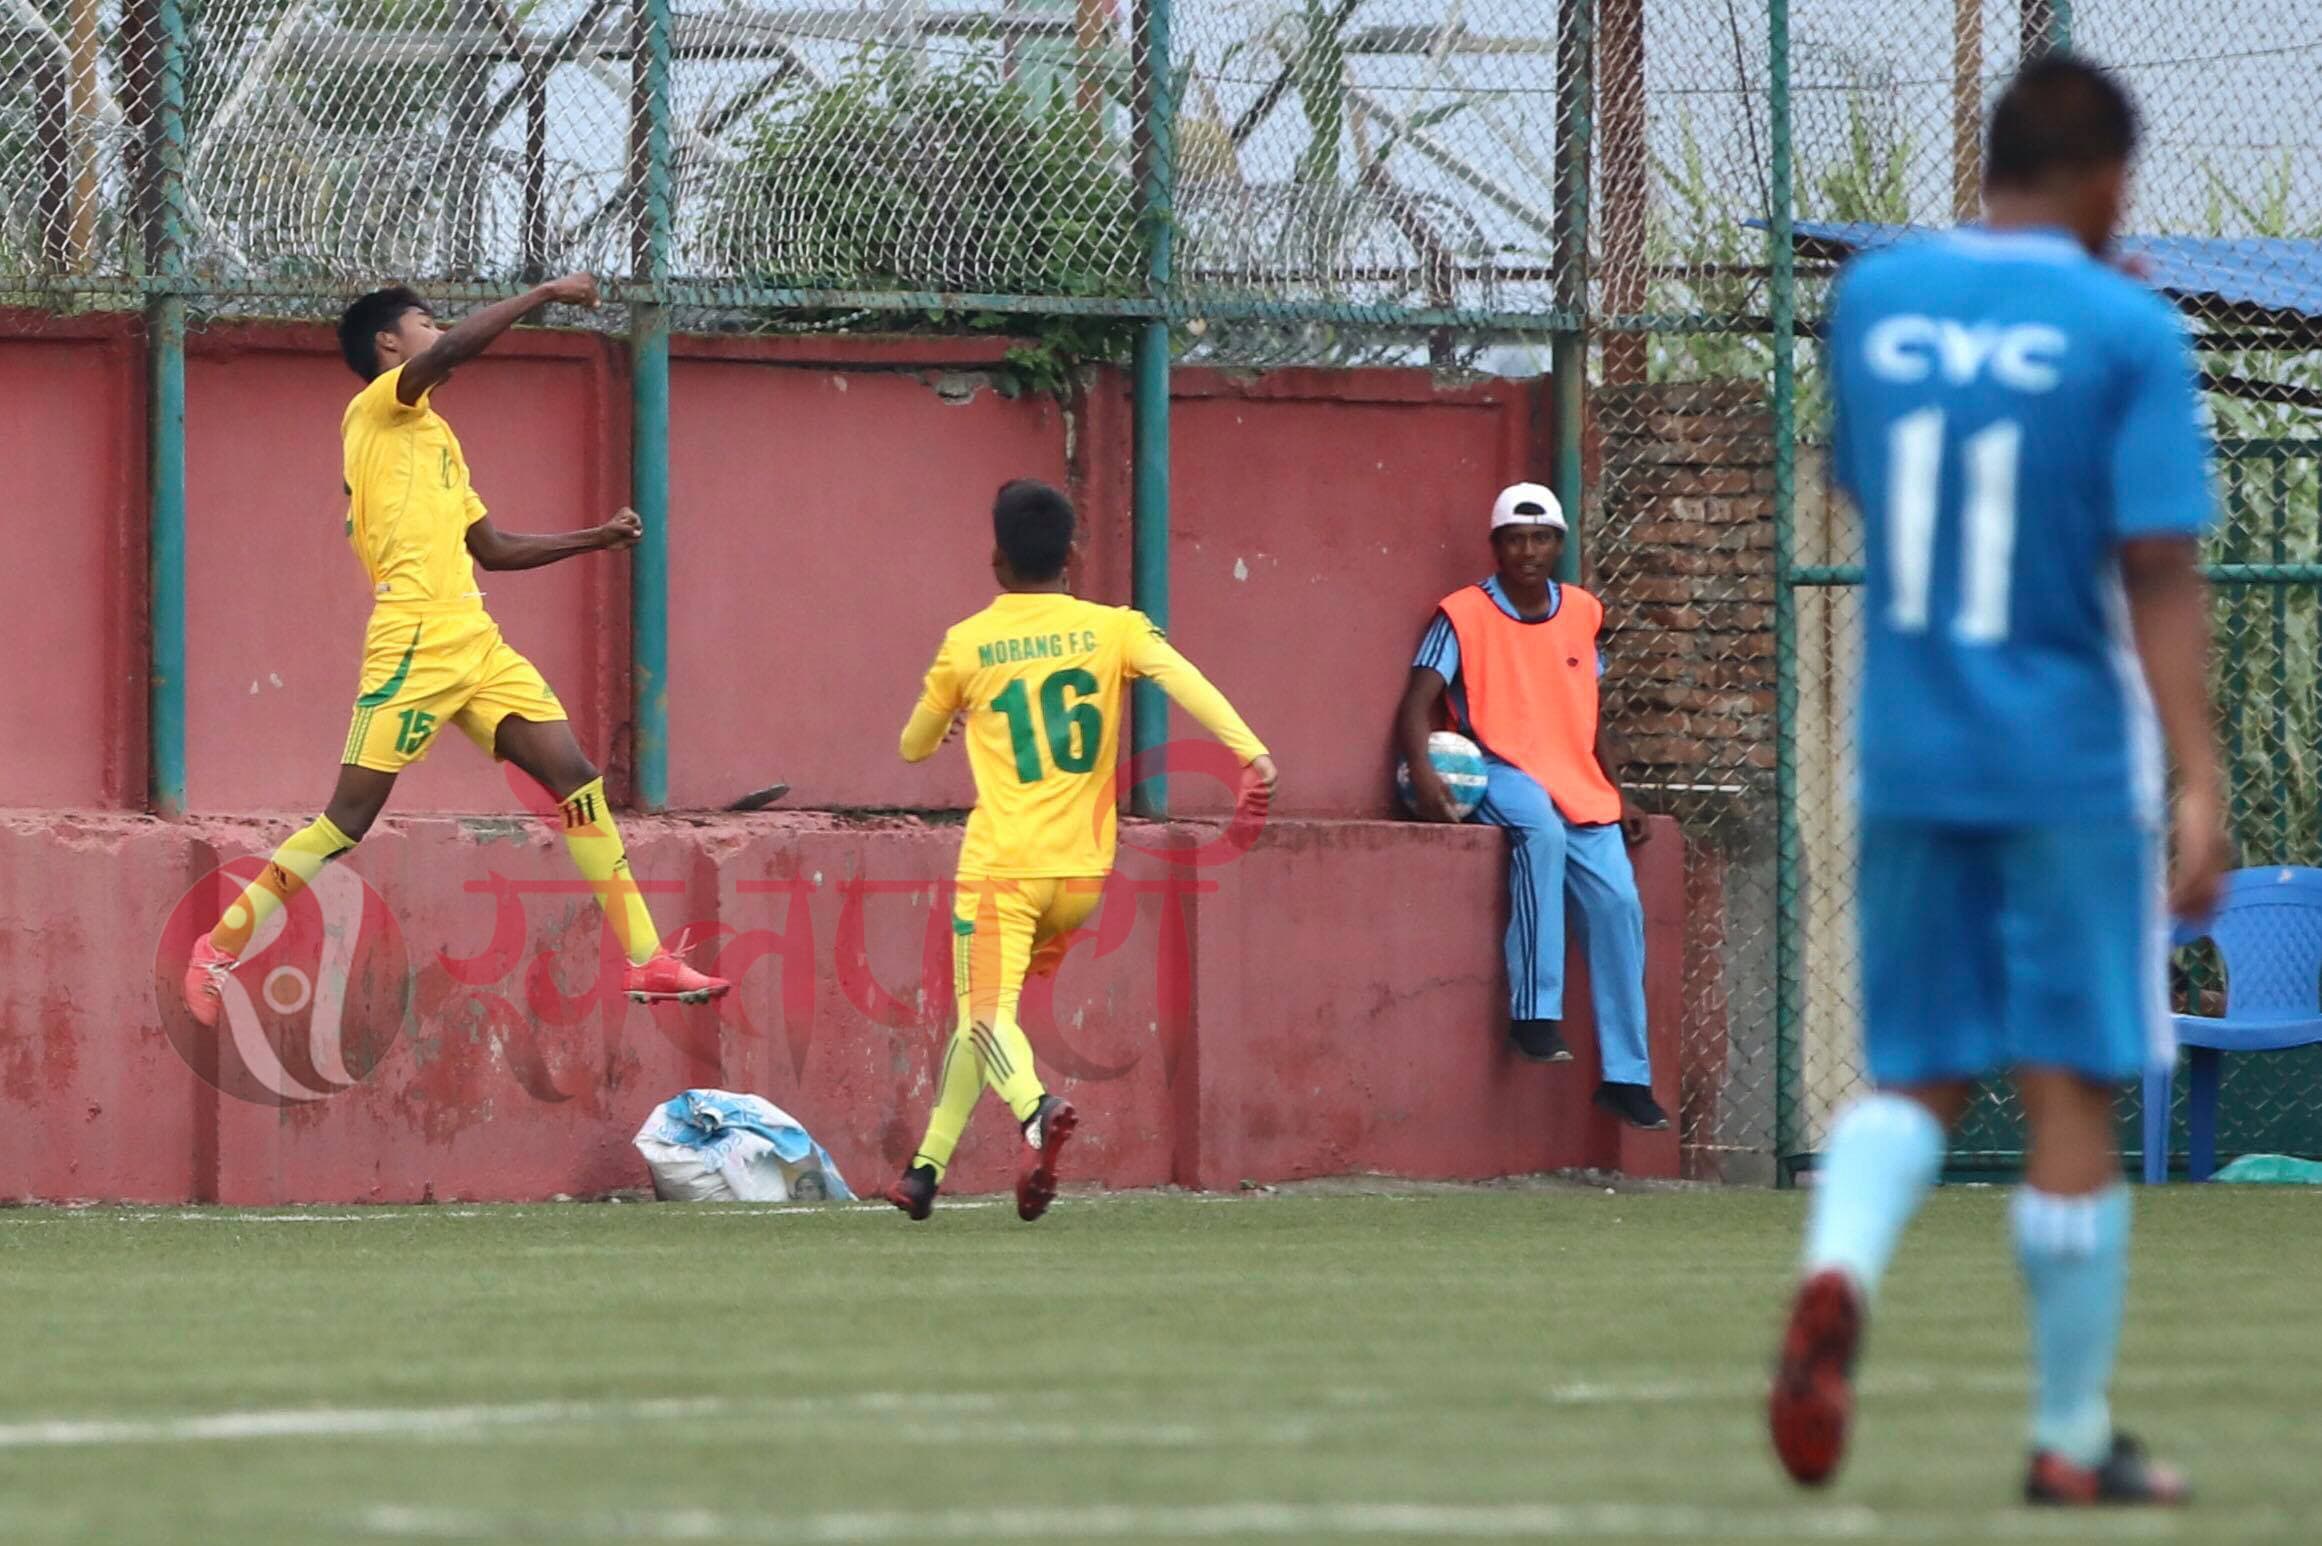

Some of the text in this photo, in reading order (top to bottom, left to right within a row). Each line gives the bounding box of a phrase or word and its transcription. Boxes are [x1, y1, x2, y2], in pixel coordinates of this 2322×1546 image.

[1864, 314, 2067, 392] CYC
[1887, 407, 2022, 646] 11
[978, 634, 1062, 668] MORANG
[396, 709, 436, 755] 15
[991, 668, 1103, 783] 16
